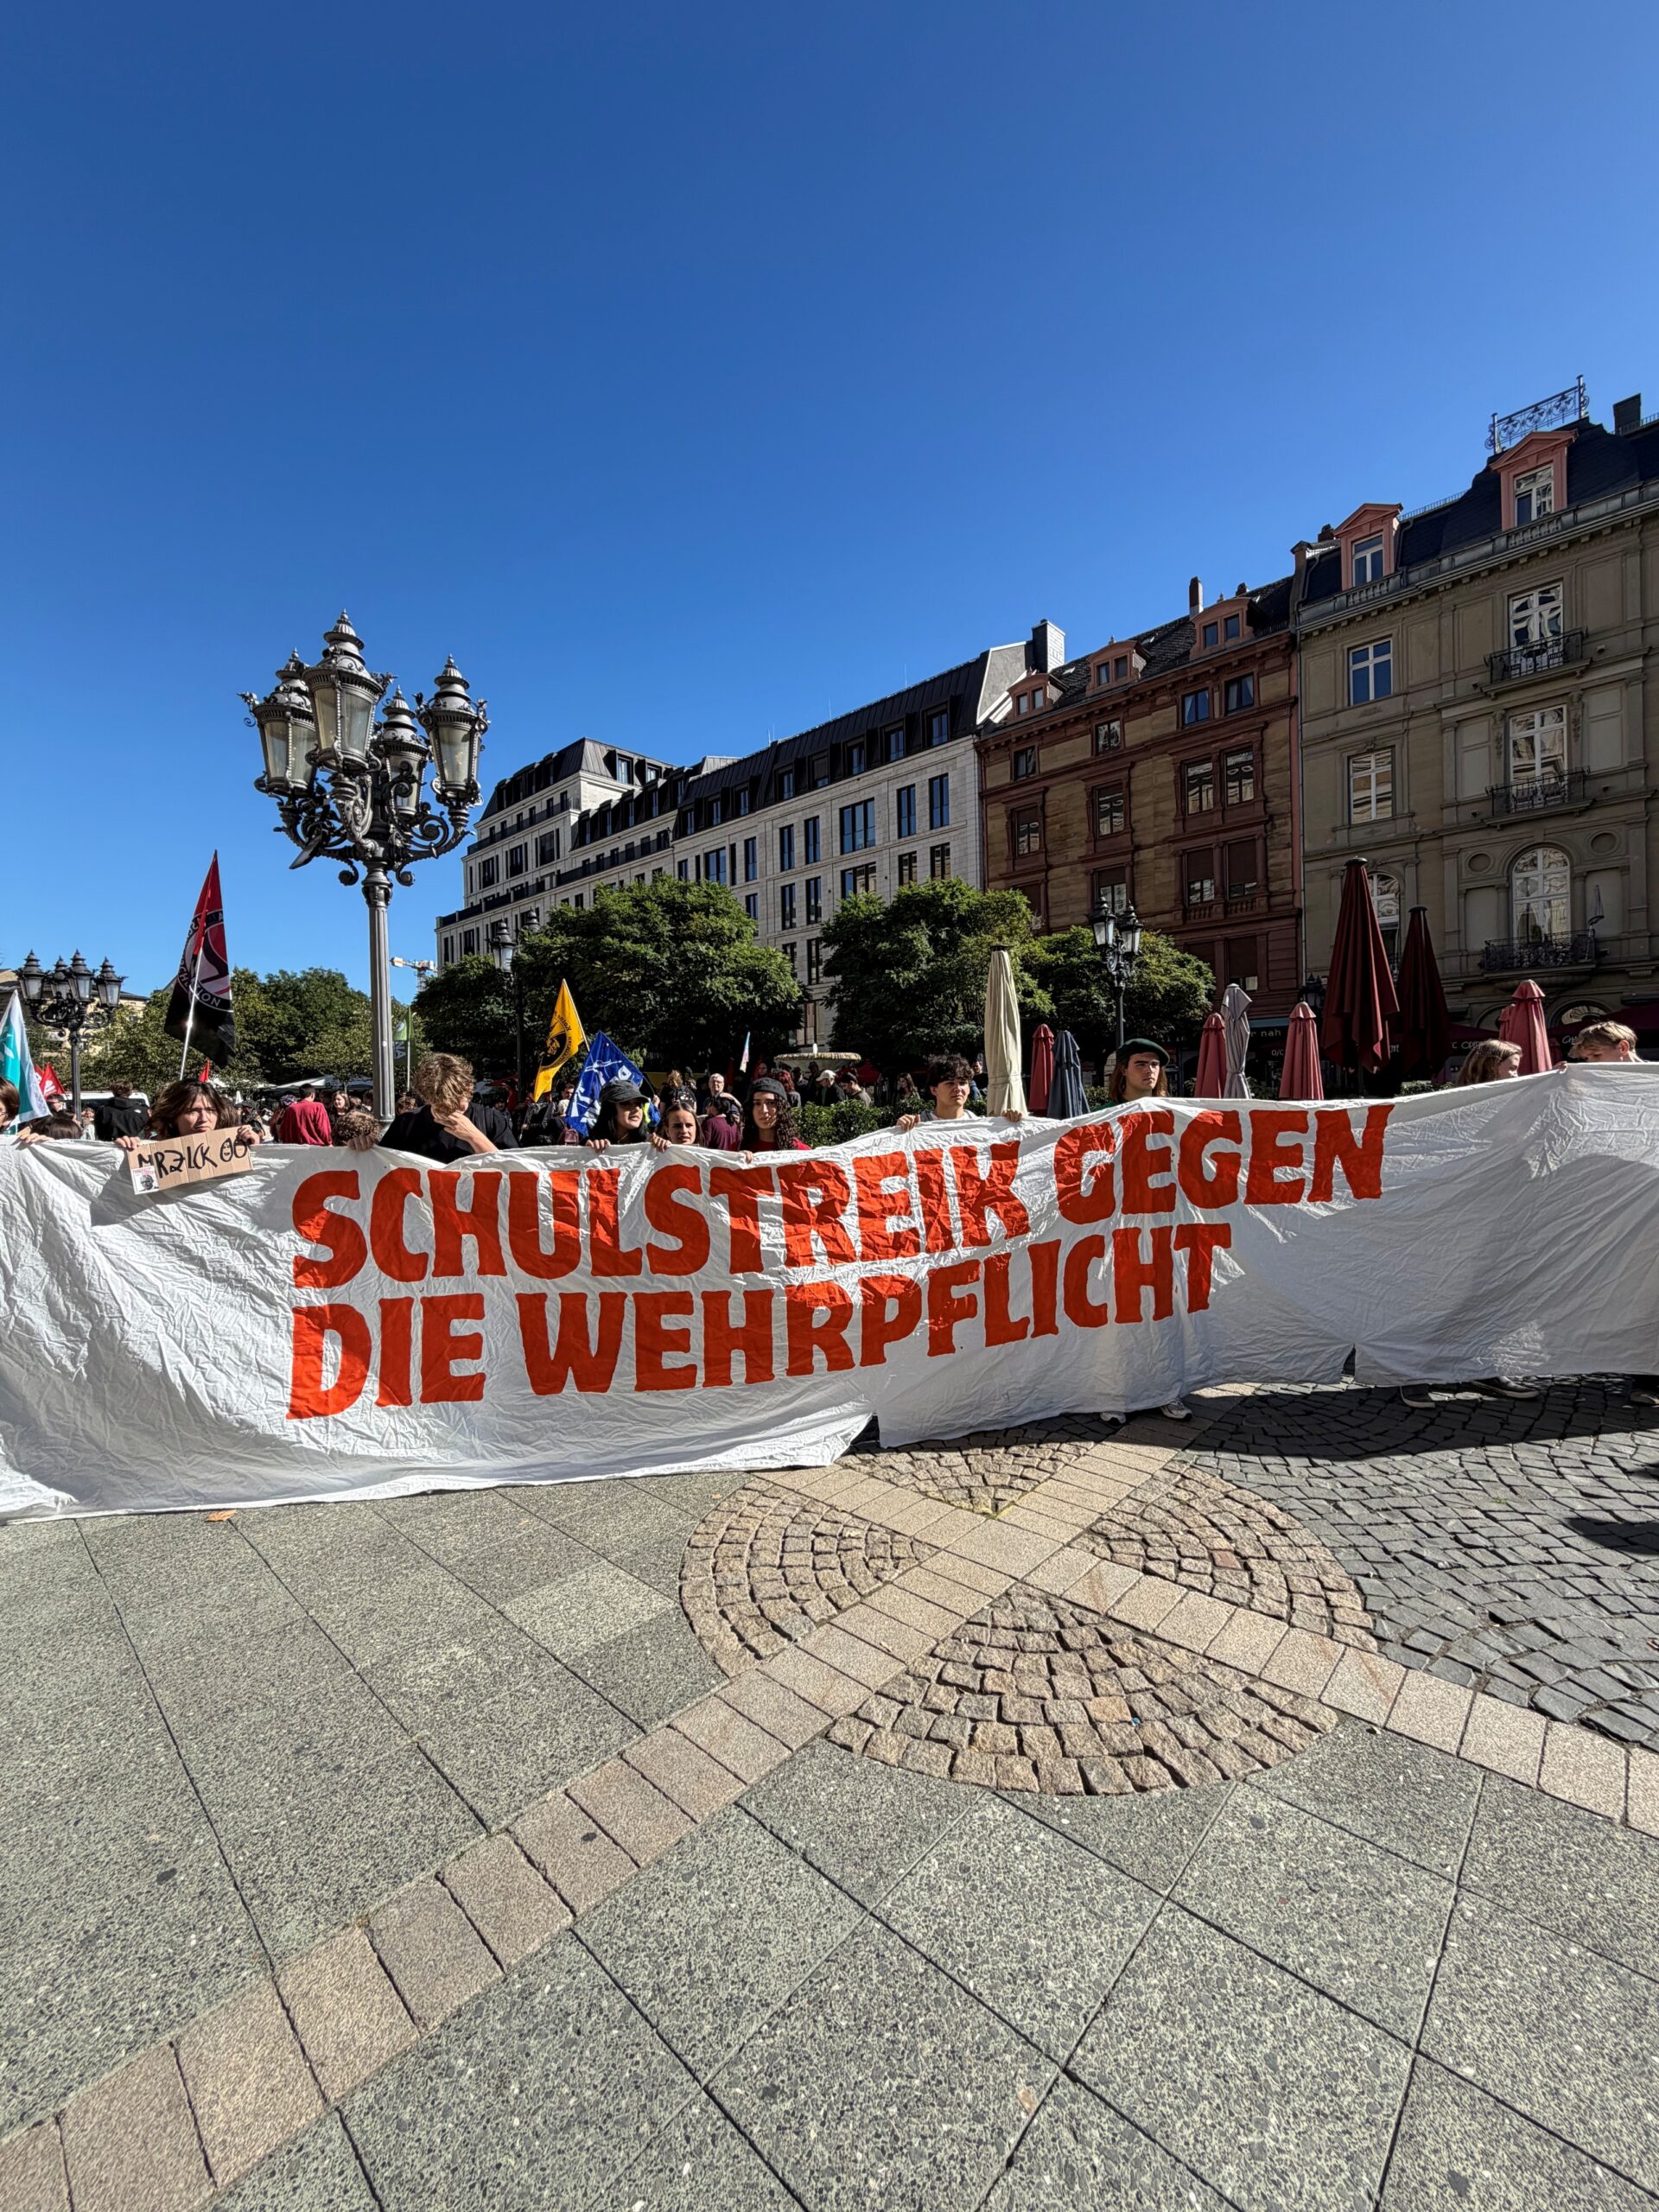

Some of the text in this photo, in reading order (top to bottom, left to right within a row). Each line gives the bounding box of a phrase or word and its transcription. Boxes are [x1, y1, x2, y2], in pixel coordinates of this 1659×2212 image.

[292, 1104, 1394, 1287] SCHULSTREIK GEGEN
[286, 1223, 1231, 1420] DIE WEHRPFLICHT
